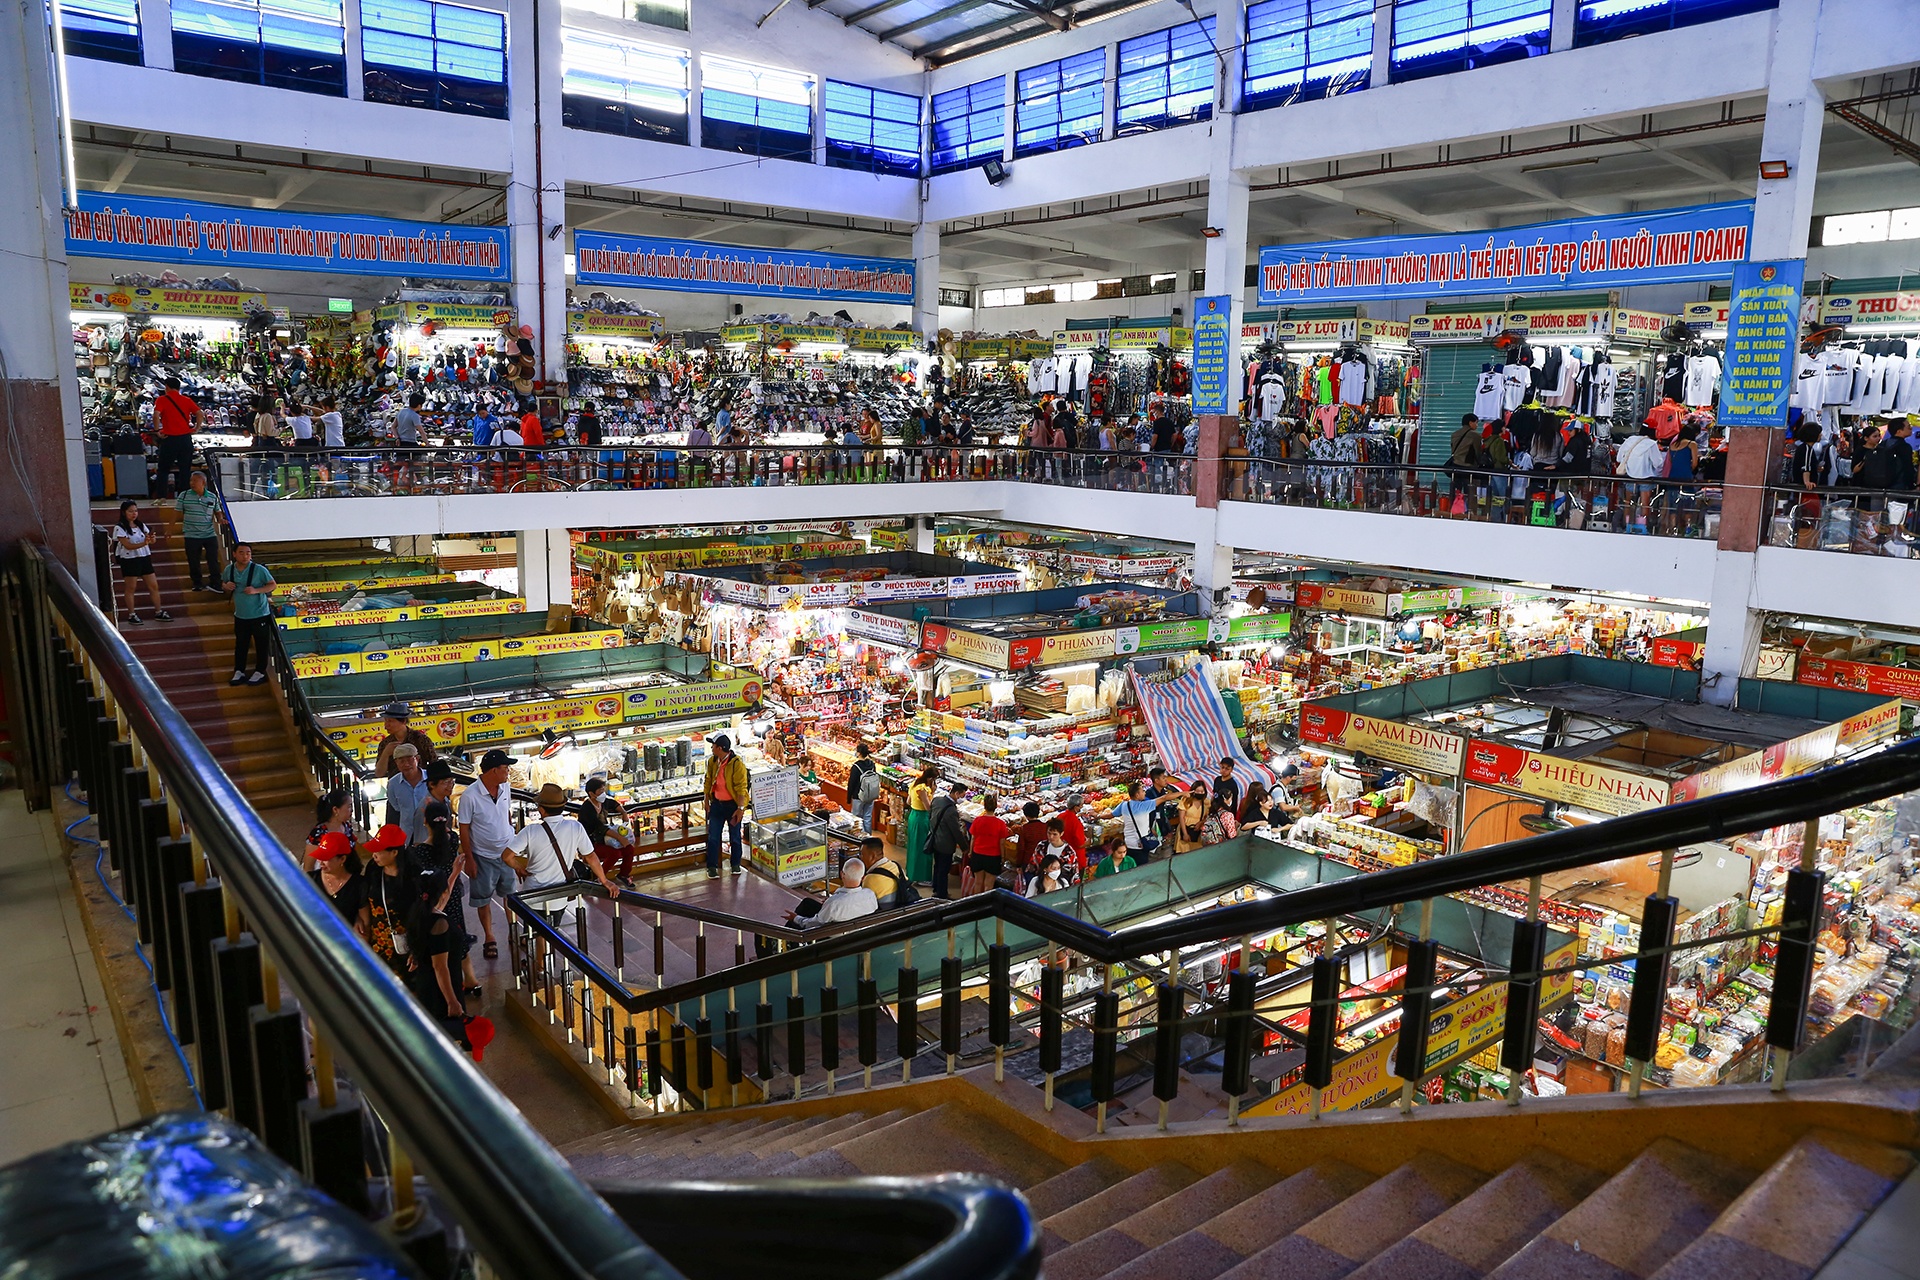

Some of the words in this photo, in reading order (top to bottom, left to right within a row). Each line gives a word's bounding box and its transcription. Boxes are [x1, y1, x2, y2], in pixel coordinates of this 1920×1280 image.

[94, 206, 113, 243] GIỮ
[114, 208, 144, 245] VỮNG
[145, 217, 173, 247] DANH
[175, 214, 199, 255] HIỆU
[229, 219, 249, 252] VĂN
[250, 225, 276, 254] MINH
[277, 225, 314, 257] THƯƠNG
[339, 233, 352, 259] DO
[353, 234, 377, 260] UBND
[379, 229, 406, 263] THÀNH
[408, 229, 426, 264] PHỐ
[426, 233, 438, 265] ĐÀ
[440, 231, 461, 266] NẴNG
[463, 239, 477, 267] GHI
[478, 237, 500, 273] NHẬN
[580, 248, 597, 272] MUA
[597, 244, 611, 274] BÁN
[612, 246, 631, 275] HÀNG
[631, 248, 646, 277] HÓA
[680, 249, 694, 280] GỐC
[694, 251, 711, 282] XUẤT
[730, 256, 747, 284] RÀNG
[747, 257, 756, 284] LÀ
[1264, 261, 1288, 297] THỰC
[1290, 257, 1312, 295] HIỆN
[1314, 253, 1332, 289] TỐT
[1333, 255, 1353, 287] VĂN
[1354, 257, 1383, 286] MINH
[1384, 251, 1427, 285] THƯƠNG
[1428, 253, 1451, 289] MẠI
[1452, 244, 1467, 281] LÀ
[1469, 236, 1494, 280] THỂ
[1494, 240, 1523, 284] HIỆN
[1525, 237, 1549, 276] NÉT
[1551, 242, 1578, 282] ĐẸP
[1579, 230, 1607, 273] CỦA
[1609, 228, 1654, 270] NGƯỜI
[1654, 231, 1692, 267] KINH
[1692, 225, 1748, 264] DOANH
[205, 294, 240, 305] LINH
[494, 313, 510, 324] 258
[626, 318, 648, 327] ANH
[1433, 316, 1452, 331] MỸ
[1455, 315, 1482, 330] HÒA
[1530, 313, 1566, 328] HƯƠNG
[1567, 314, 1587, 327] SEN
[1629, 313, 1648, 329] HƯƠNG
[1650, 318, 1661, 331] SEN
[1296, 321, 1311, 334] LÝ
[1315, 322, 1339, 335] LỰU
[1374, 322, 1387, 335] LÝ
[1070, 334, 1080, 342] NA
[1082, 333, 1093, 342] NA
[1148, 331, 1158, 339] AN
[811, 368, 824, 381] 256
[1772, 380, 1782, 388] VI
[1735, 393, 1746, 402] VI
[1339, 593, 1360, 604] THU
[1362, 594, 1376, 606] HÀ
[444, 609, 475, 617] THANH
[335, 619, 355, 627] KIM
[1095, 632, 1115, 645] YẾN
[989, 640, 1006, 655] YẾN
[404, 654, 441, 664] THANH
[443, 652, 462, 661] CHI
[669, 694, 696, 706] NUÔI
[1852, 716, 1873, 734] HẢI
[1875, 706, 1899, 725] ANH
[1367, 720, 1405, 742] NAM
[1409, 730, 1459, 754] ĐỊNH
[1531, 761, 1540, 769] 35
[1545, 765, 1594, 788] HIẾU
[1598, 778, 1664, 805] NHÂN
[1456, 1002, 1477, 1015] GIA
[1460, 1003, 1496, 1030] SƠN
[1431, 1023, 1447, 1034] 154
[1349, 1050, 1379, 1073] PHẨM
[1275, 1095, 1296, 1111] GIA
